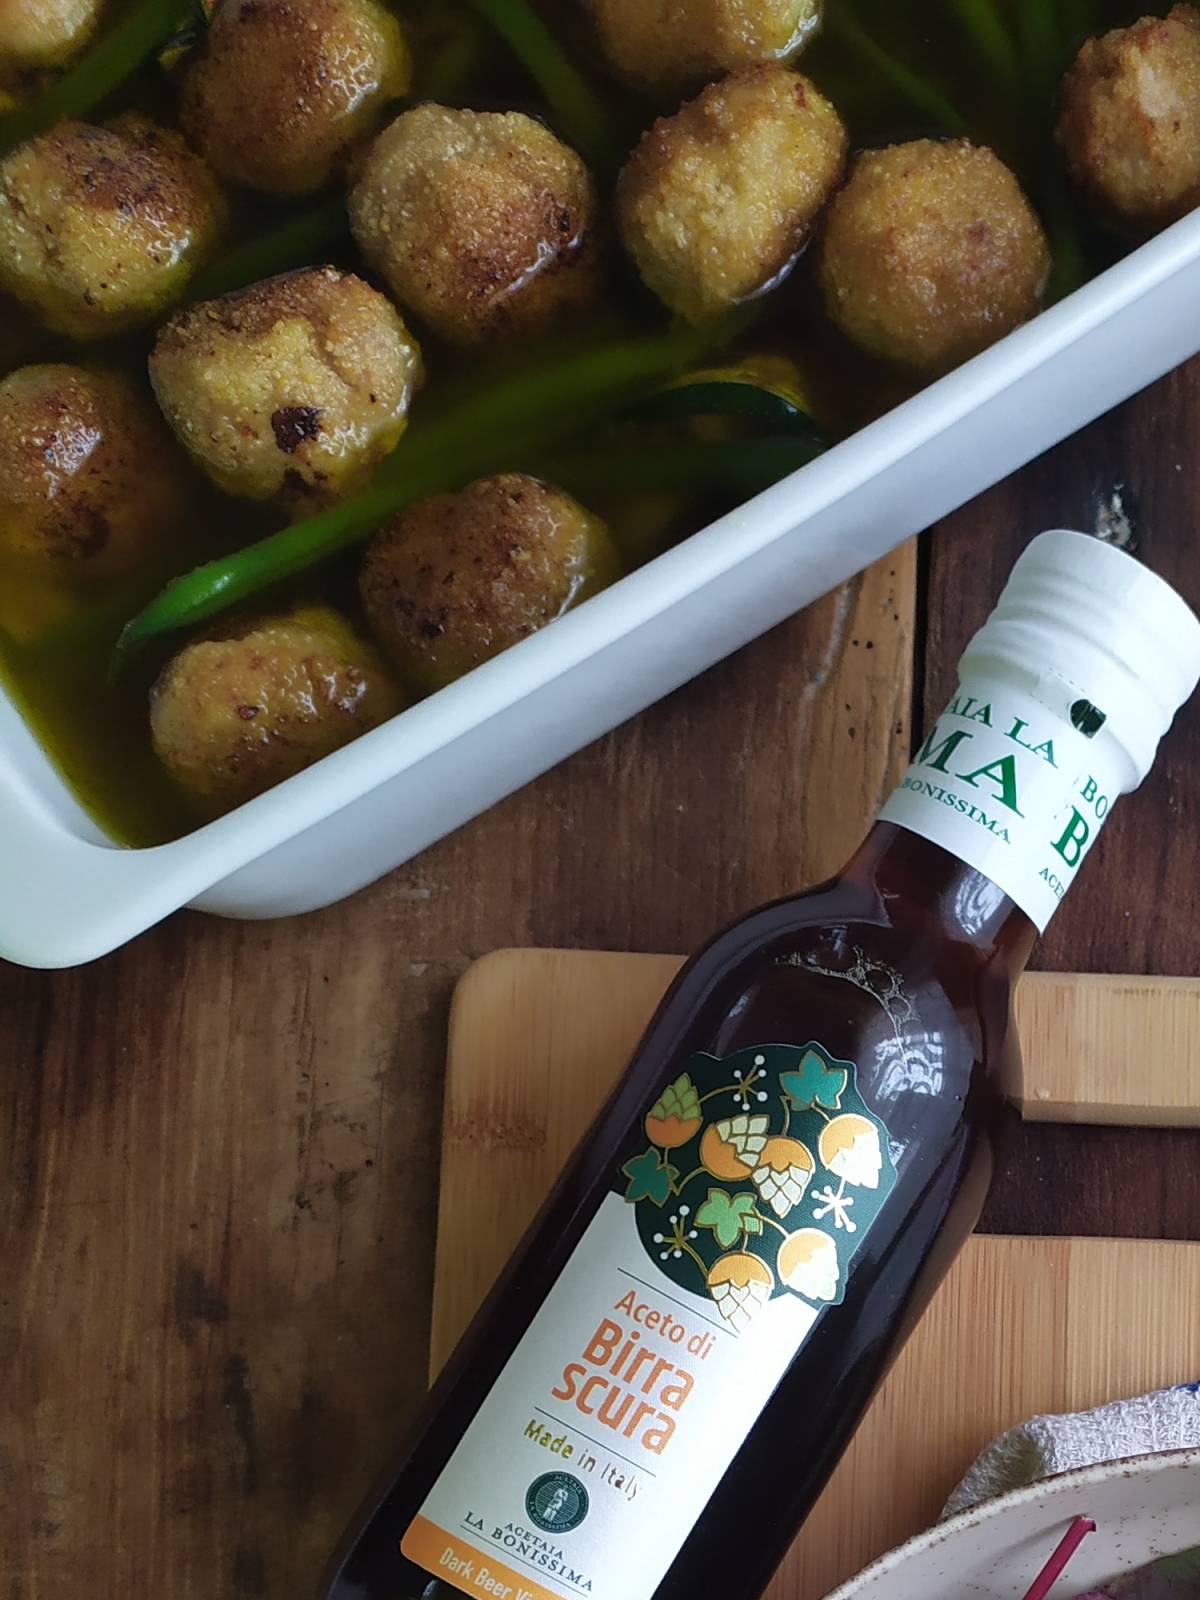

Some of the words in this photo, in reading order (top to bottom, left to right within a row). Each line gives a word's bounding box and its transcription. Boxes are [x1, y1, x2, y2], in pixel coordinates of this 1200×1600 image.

[918, 726, 1025, 818] MA
[1050, 805, 1089, 868] B
[945, 696, 993, 728] AIA
[1004, 716, 1058, 768] LA
[1080, 774, 1109, 819] BO
[1038, 867, 1064, 901] ACE
[582, 1318, 694, 1411] Birra
[614, 1290, 685, 1343] Aceto
[687, 1332, 716, 1360] di
[551, 1363, 676, 1455] scura
[524, 1420, 574, 1459] Made
[577, 1449, 596, 1473] in
[601, 1463, 639, 1501] Italy
[440, 1547, 474, 1579] Dark
[474, 1567, 512, 1599] Beer
[464, 1512, 485, 1531] LA
[491, 1527, 593, 1592] BONISSIMA
[504, 1522, 563, 1560] ACETAIA
